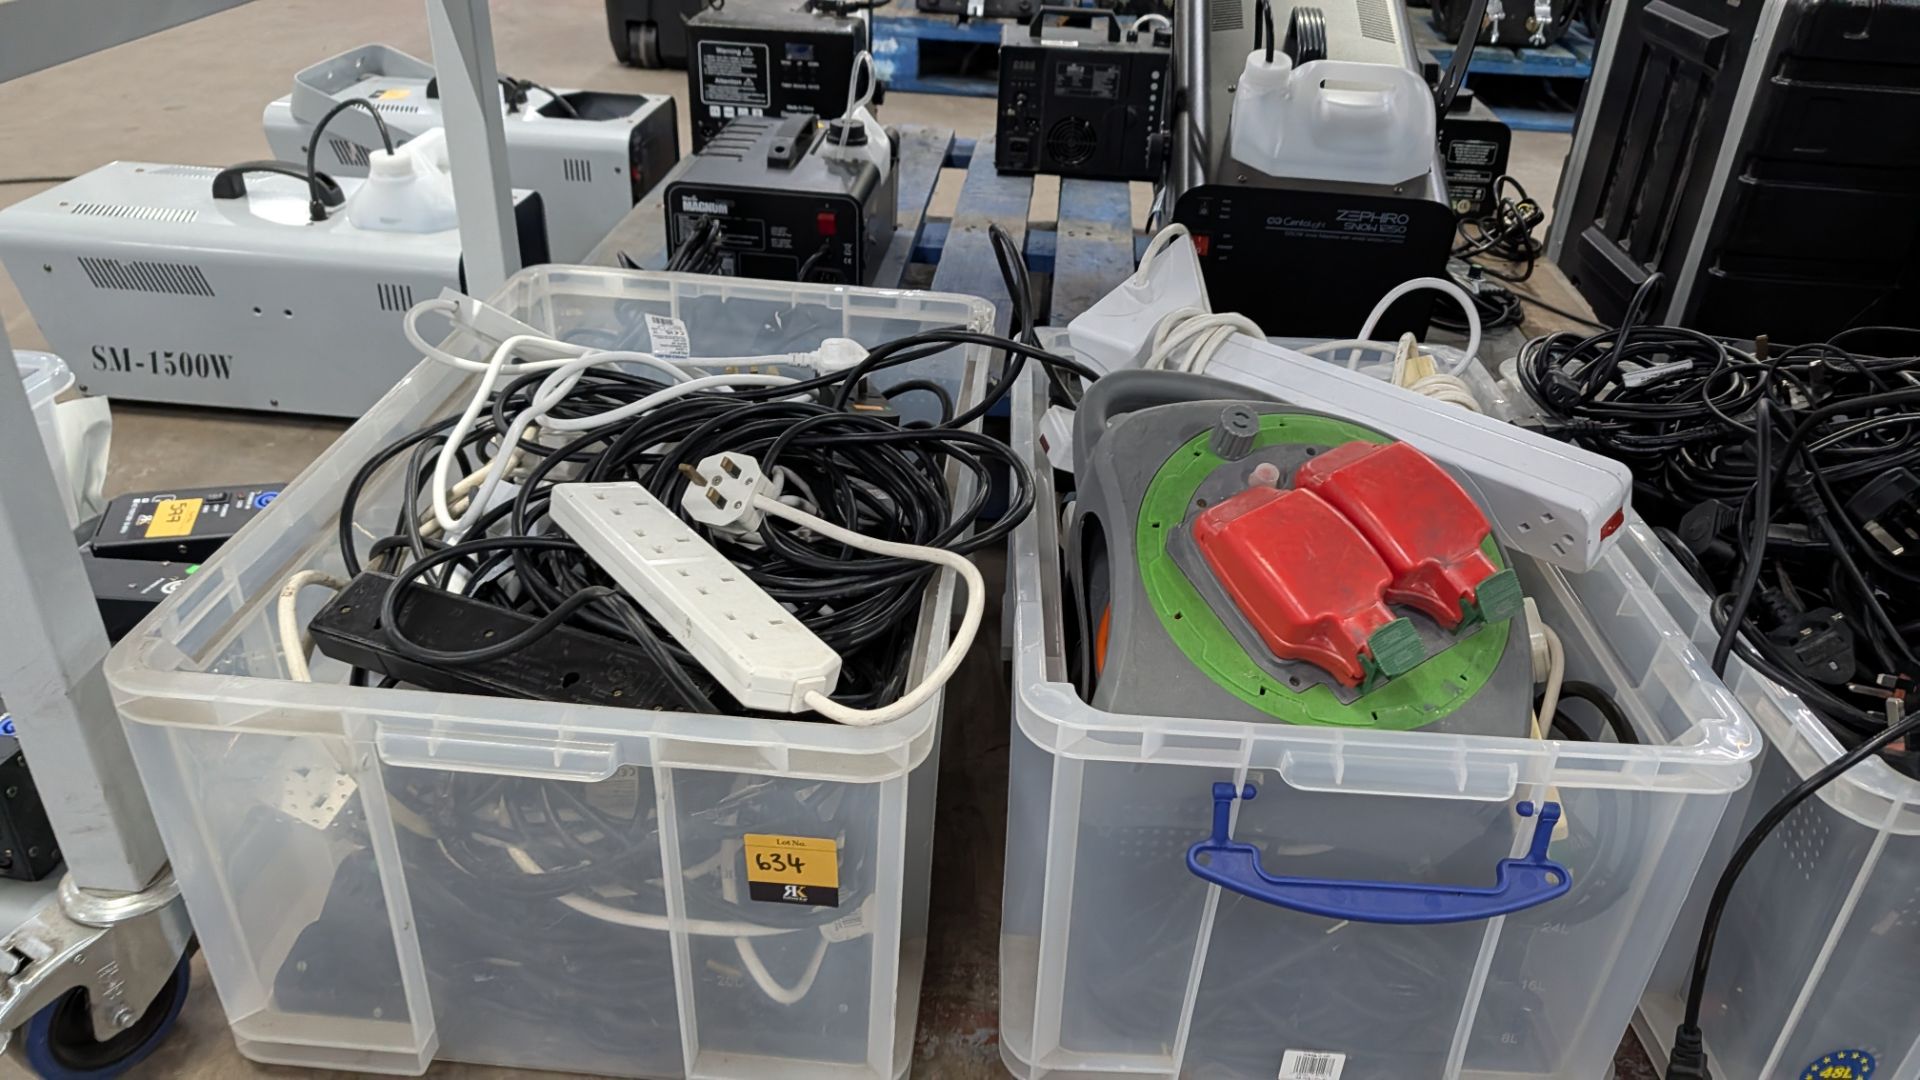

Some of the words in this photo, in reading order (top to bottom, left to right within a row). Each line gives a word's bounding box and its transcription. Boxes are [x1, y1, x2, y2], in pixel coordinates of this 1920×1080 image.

[1336, 209, 1410, 225] ZEPHIRO
[1343, 222, 1378, 233] SNOW
[91, 344, 233, 380] SM-1500W
[756, 853, 806, 874] 634
[1820, 1066, 1852, 1078] 48L
